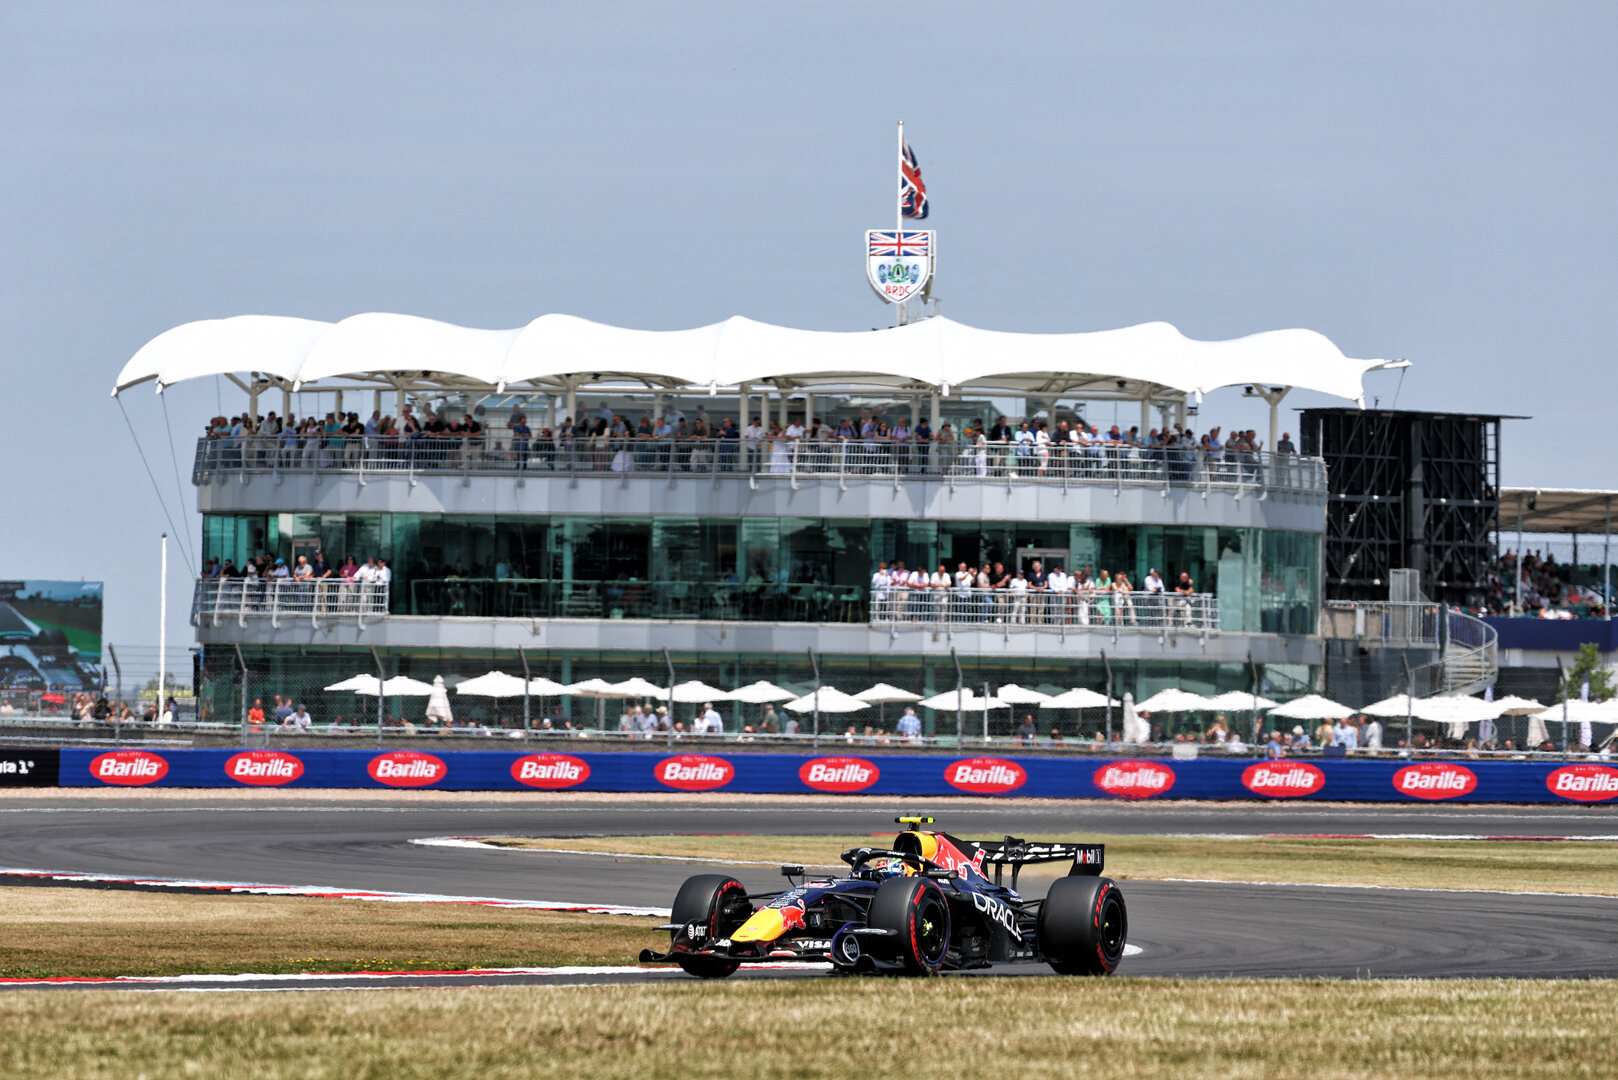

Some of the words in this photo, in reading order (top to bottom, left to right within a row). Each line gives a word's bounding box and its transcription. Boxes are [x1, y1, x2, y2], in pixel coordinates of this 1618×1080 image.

[886, 285, 911, 296] BRDC
[99, 758, 159, 776] Barilla
[234, 758, 294, 777] Barilla
[376, 759, 437, 777] Barilla
[520, 761, 580, 779] Barilla
[663, 762, 725, 781] Barilla
[808, 764, 870, 782] Barilla
[954, 765, 1017, 785] Barilla
[1101, 767, 1167, 788] Barilla
[1251, 769, 1315, 788] Barilla
[1402, 771, 1467, 790] Barilla
[1556, 773, 1618, 791] Barilla
[1076, 848, 1095, 864] Mobil
[1096, 848, 1102, 864] 1
[971, 891, 1022, 942] ORACLE
[797, 940, 832, 949] VISA
